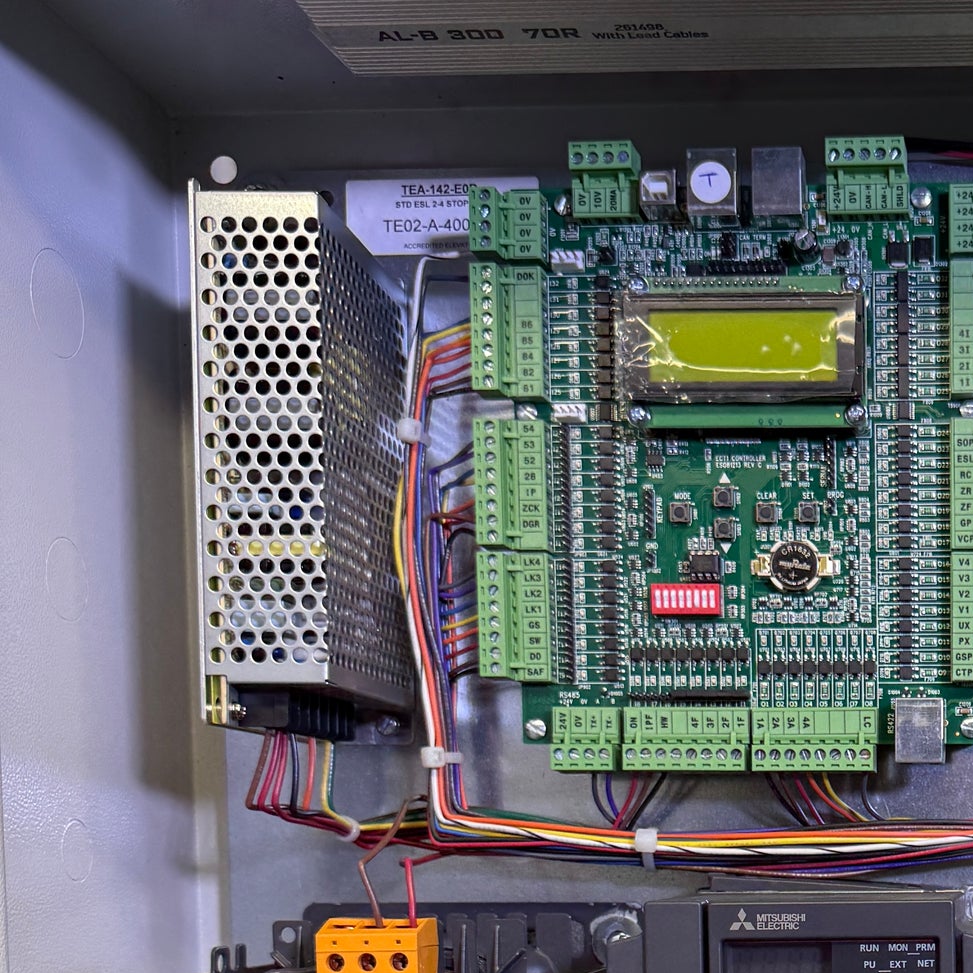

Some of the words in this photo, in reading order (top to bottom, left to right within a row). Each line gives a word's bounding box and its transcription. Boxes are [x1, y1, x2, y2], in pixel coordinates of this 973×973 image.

[379, 30, 438, 42] AL-B
[447, 29, 504, 40] 300
[522, 28, 580, 39] 70R
[664, 30, 709, 39] Cables
[698, 172, 718, 187] T
[401, 184, 478, 195] TEA-142-E0
[433, 200, 444, 208] 2-4
[957, 438, 973, 447] SOP
[957, 454, 973, 463] ESL
[960, 470, 972, 479] RC
[961, 486, 972, 495] ZR
[522, 504, 540, 512] ZCK
[961, 503, 972, 511] ZF
[523, 520, 540, 528] DGR
[960, 519, 972, 527] GP
[524, 558, 540, 567] LK4
[959, 558, 970, 567] V4
[524, 574, 541, 582] LK3
[959, 574, 970, 583] V3
[525, 589, 542, 598] LK2
[959, 590, 970, 598] V2
[525, 605, 542, 613] LK1
[528, 621, 540, 630] GS
[959, 621, 970, 630] UX
[529, 637, 541, 645] SW
[959, 637, 970, 645] PX
[956, 653, 973, 661] GSP
[527, 667, 544, 676] SAF
[956, 668, 973, 677] CTP
[691, 717, 699, 728] 4F
[707, 717, 714, 728] 3F
[721, 717, 730, 728] 2F
[757, 913, 806, 922] MITSUBISHI
[757, 922, 800, 930] ELECTRIC
[860, 944, 880, 952] RUN
[888, 943, 908, 951] MON
[916, 943, 935, 951] PRM
[864, 961, 876, 969] PU
[890, 961, 907, 969] EXT
[917, 960, 935, 968] NET
